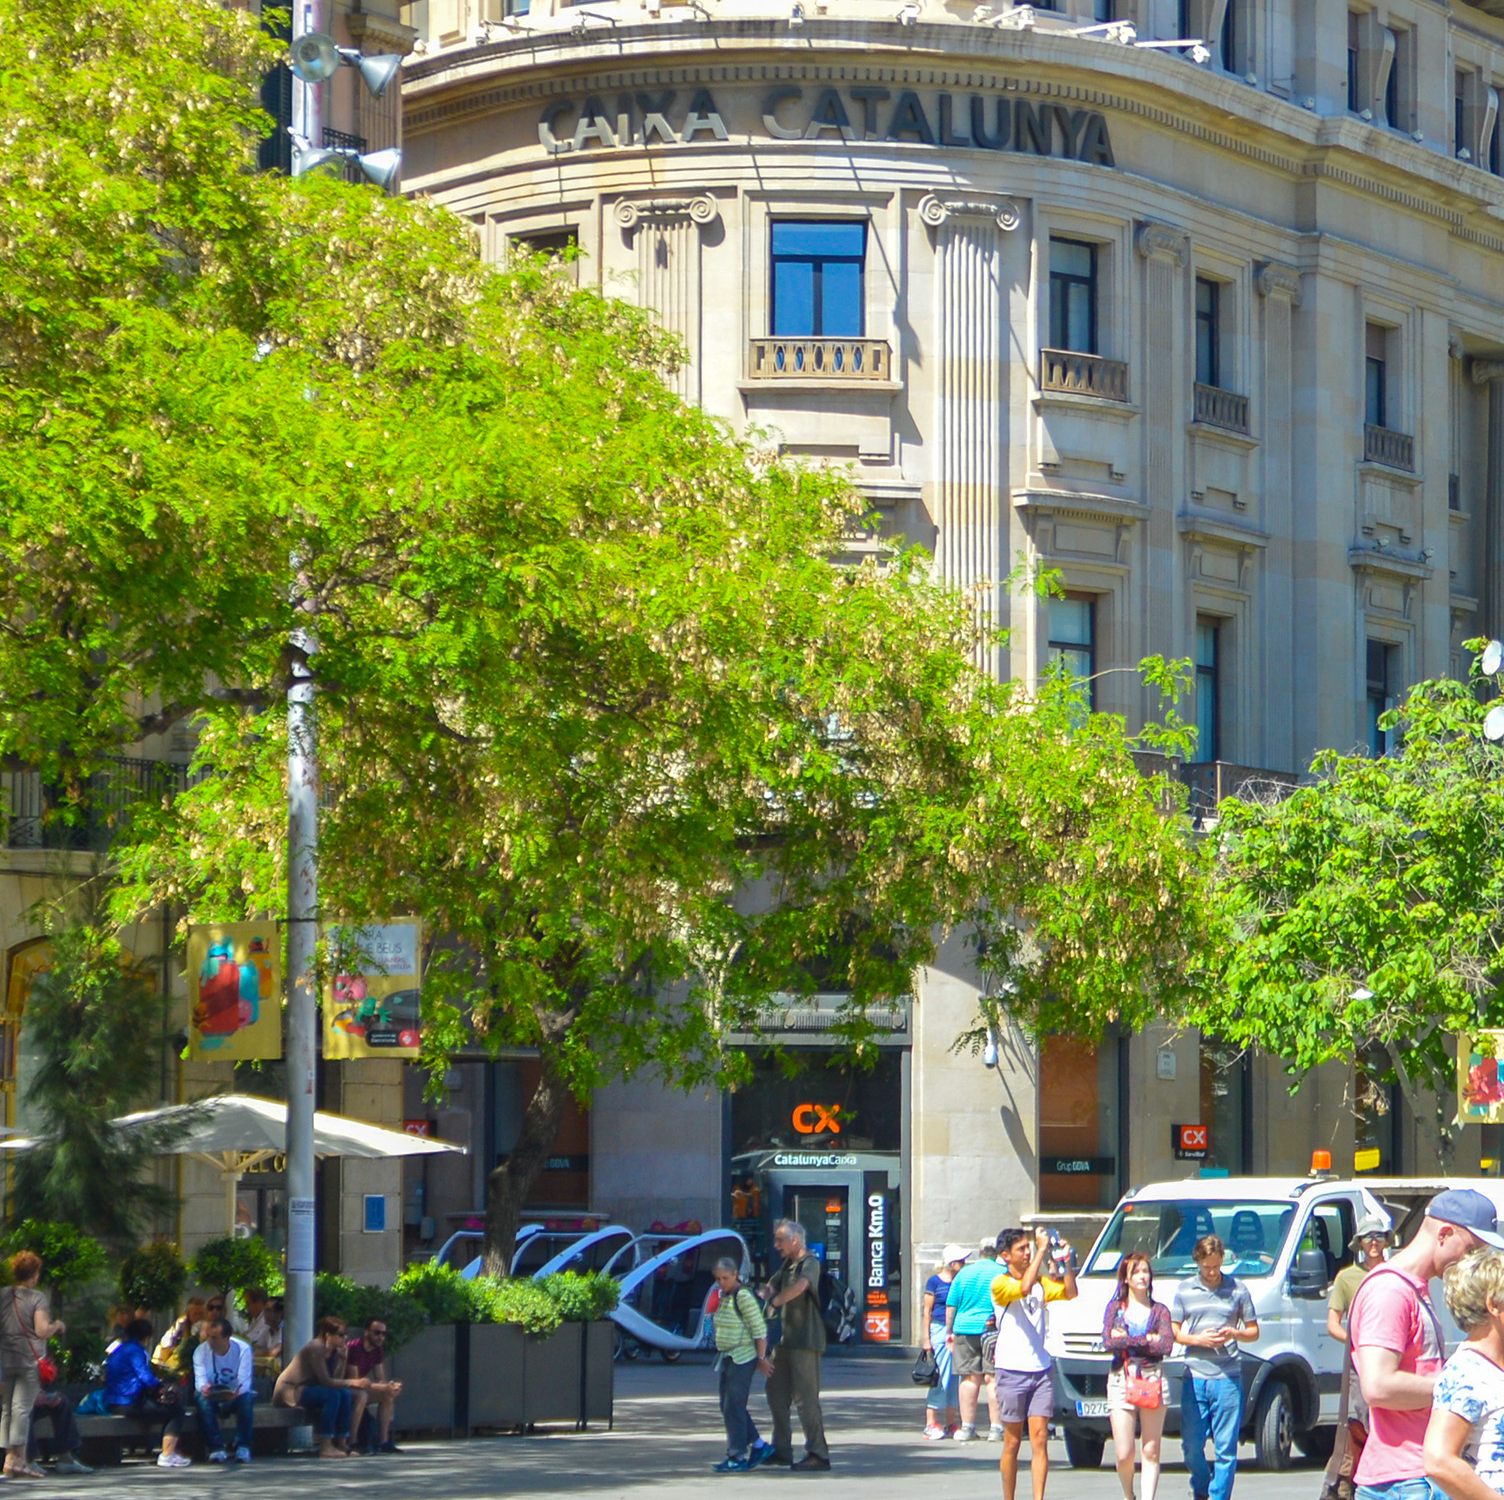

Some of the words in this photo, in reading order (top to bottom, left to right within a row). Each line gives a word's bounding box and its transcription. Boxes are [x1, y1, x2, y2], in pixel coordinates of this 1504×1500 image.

[538, 88, 729, 152] CAIXA
[762, 85, 1116, 167] CATALUNYA
[792, 1104, 840, 1134] CX
[1183, 1130, 1205, 1145] CX
[774, 1154, 857, 1167] CatalunyaCaixa
[868, 1241, 885, 1287] Banca
[865, 1318, 888, 1334] CX
